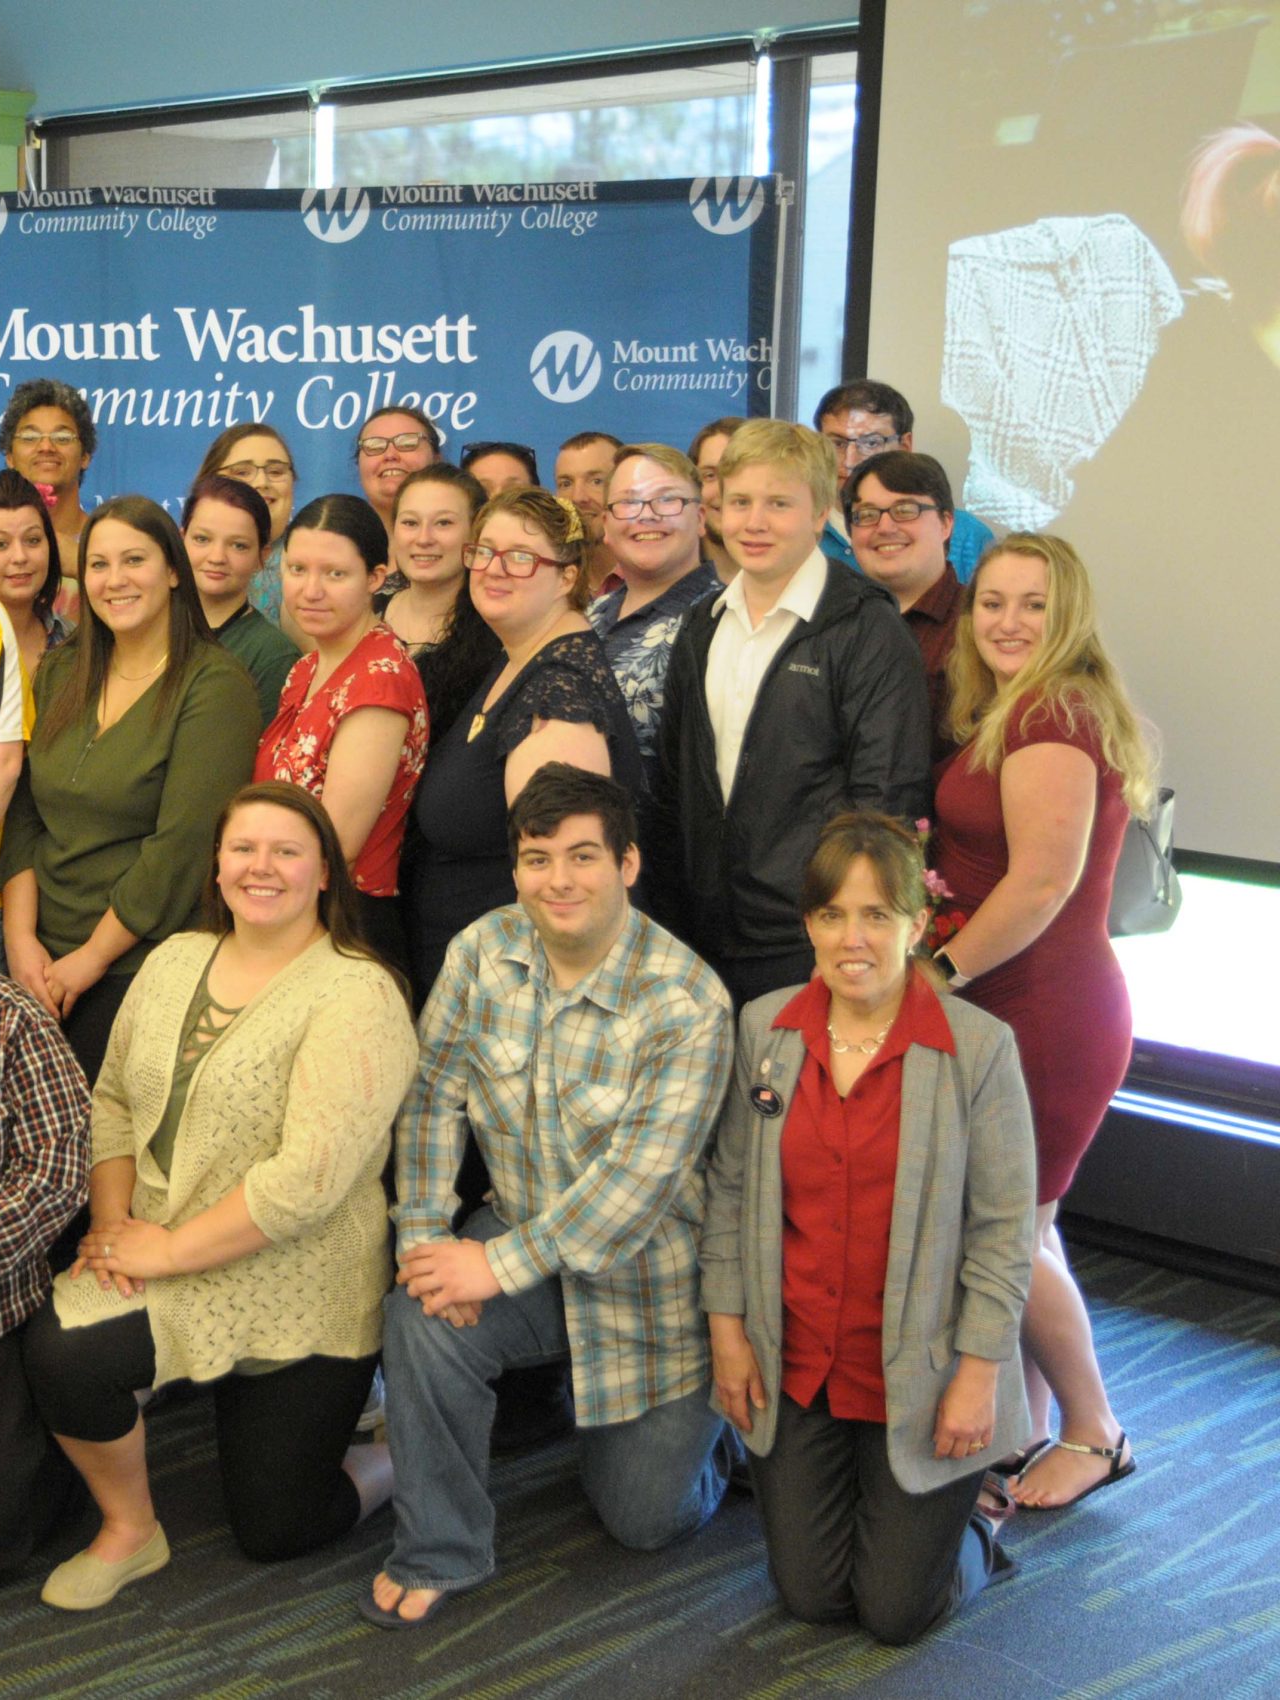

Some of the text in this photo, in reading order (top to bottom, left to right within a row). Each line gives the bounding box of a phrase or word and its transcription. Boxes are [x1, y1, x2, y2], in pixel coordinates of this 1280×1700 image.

[17, 186, 216, 208] Mount Wachusett
[380, 181, 597, 205] Mount Wachusett
[19, 206, 217, 240] Community College
[381, 203, 598, 237] Community College
[173, 304, 478, 364] Wachusett
[612, 339, 698, 364] Mount
[613, 366, 747, 397] Community
